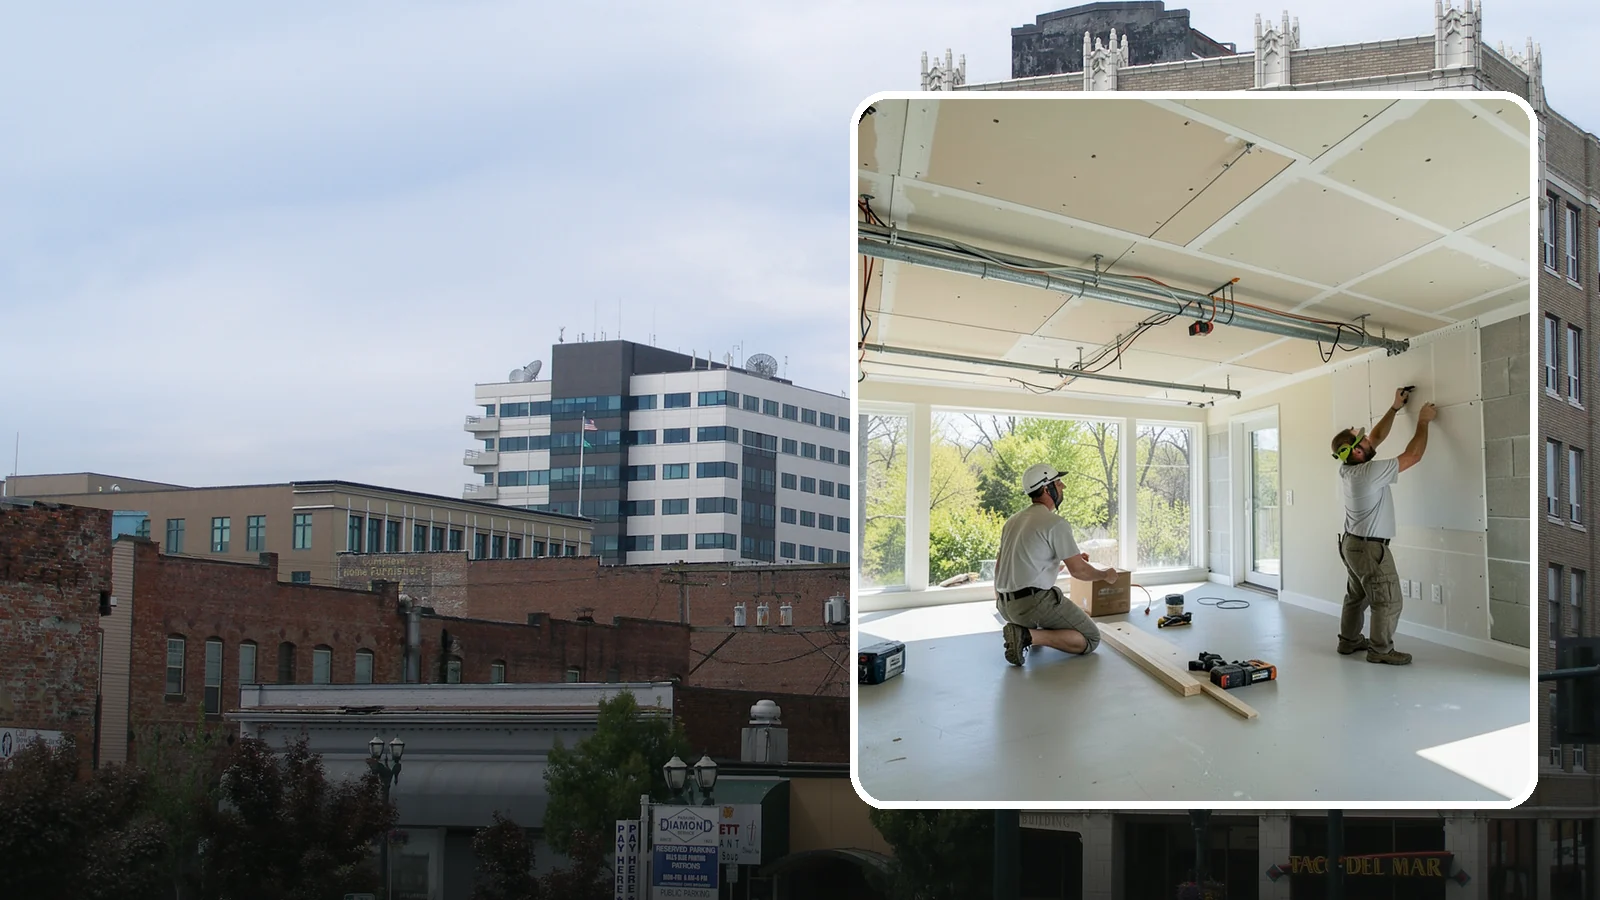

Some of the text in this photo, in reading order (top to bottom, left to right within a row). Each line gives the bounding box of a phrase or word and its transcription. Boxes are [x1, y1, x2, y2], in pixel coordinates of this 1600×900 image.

[660, 818, 713, 833] DIAMOND
[1021, 815, 1070, 828] BUILDING
[617, 824, 625, 852] PAY
[628, 824, 637, 852] PAY
[656, 845, 716, 854] RESERVED PARKING
[721, 851, 738, 862] Soup
[671, 862, 701, 870] PATRONS
[1345, 856, 1385, 875] DEL
[1392, 857, 1442, 877] MAR
[616, 856, 625, 893] HERE
[627, 856, 636, 893] HERE
[660, 888, 710, 898] PUBLIC PARKING
